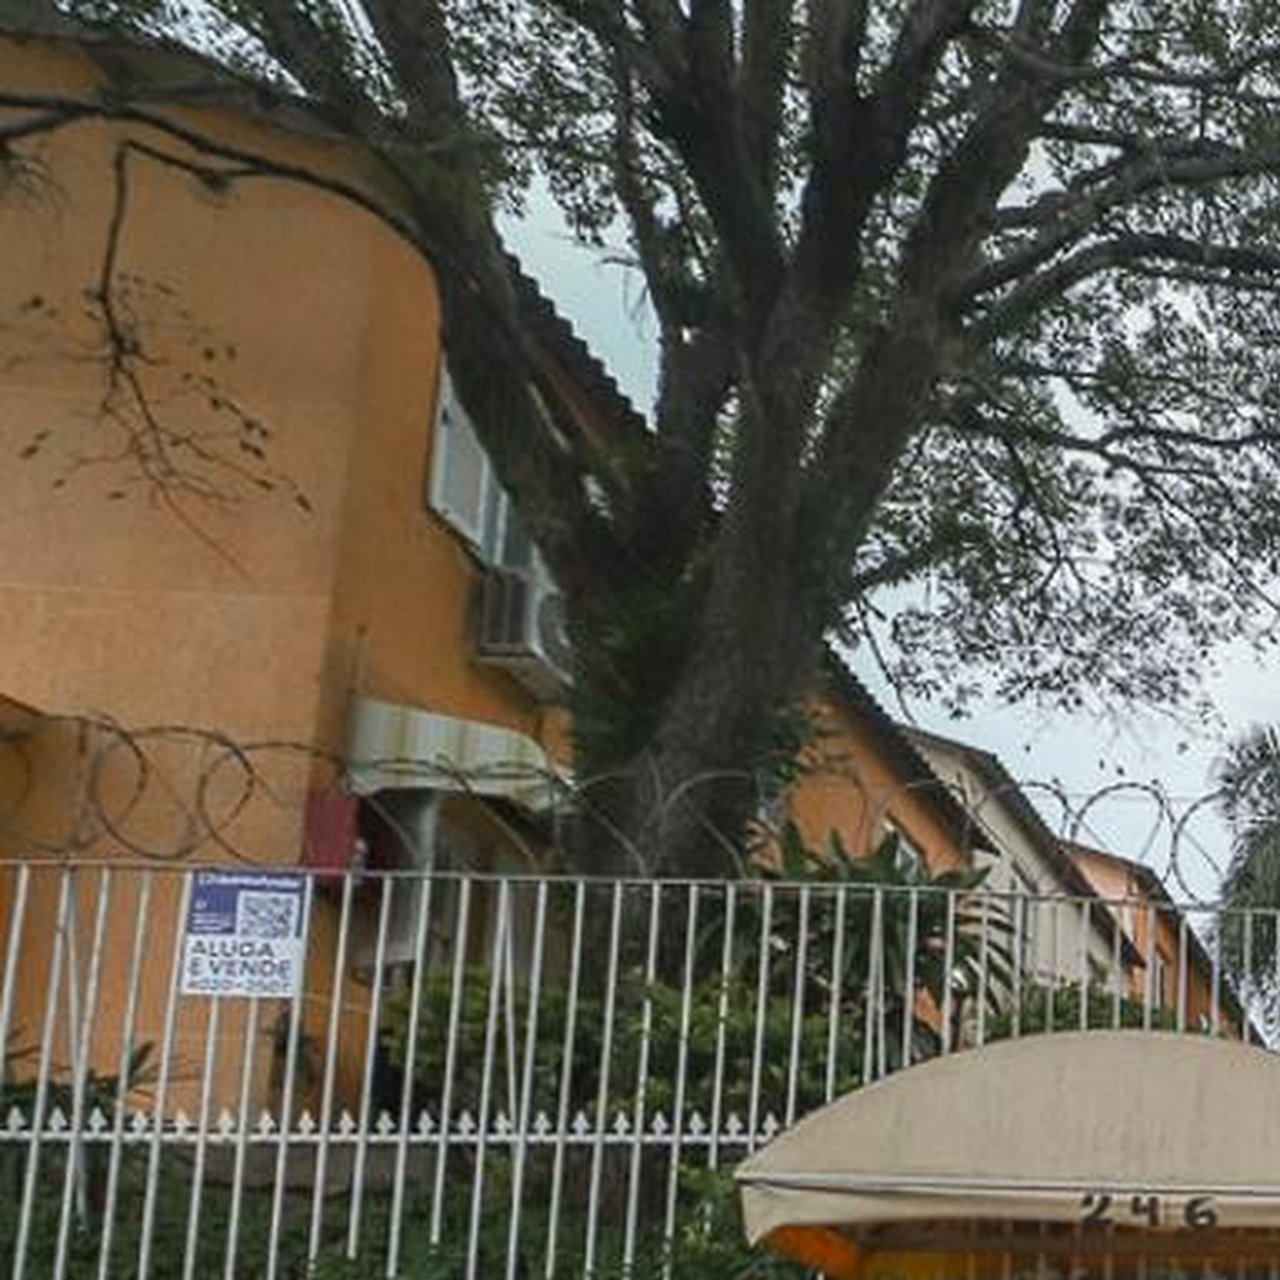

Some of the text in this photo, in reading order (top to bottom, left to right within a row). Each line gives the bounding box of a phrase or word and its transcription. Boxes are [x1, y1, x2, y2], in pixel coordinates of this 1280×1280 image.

[191, 940, 274, 957] ALUGA
[189, 957, 291, 979] E VENDE
[1082, 1194, 1217, 1228] 246
